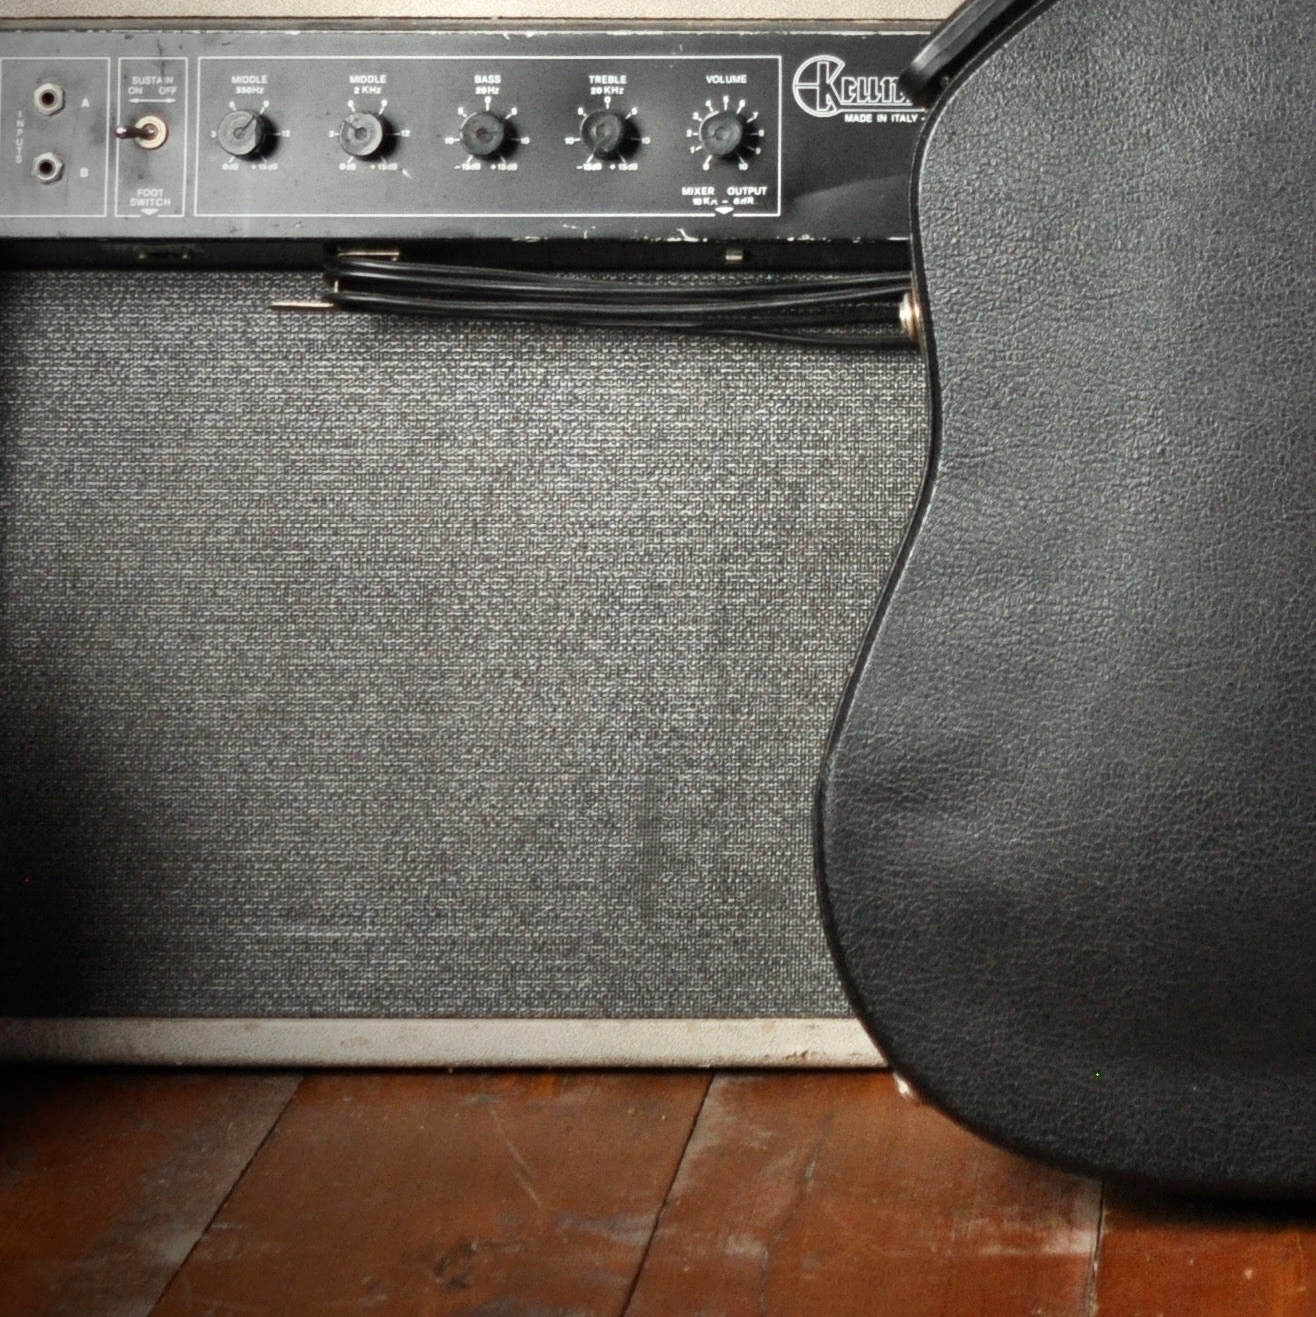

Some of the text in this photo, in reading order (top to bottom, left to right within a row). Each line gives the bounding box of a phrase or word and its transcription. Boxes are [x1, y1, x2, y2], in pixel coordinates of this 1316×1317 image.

[131, 75, 174, 85] SUSTAIN
[231, 74, 268, 84] MIDDLE
[349, 74, 387, 84] MIDDLE
[474, 74, 501, 84] BASS
[588, 74, 627, 84] TREBLE
[705, 74, 748, 84] VOLUME
[128, 86, 177, 95] ON OFF
[81, 97, 90, 108] A
[844, 113, 918, 122] MADE IN ITALY
[16, 110, 25, 164] INPUTS
[80, 168, 89, 178] B
[137, 188, 164, 197] FOOT
[681, 186, 768, 196] MIXER OUTPUT
[130, 198, 171, 207] SWITCH
